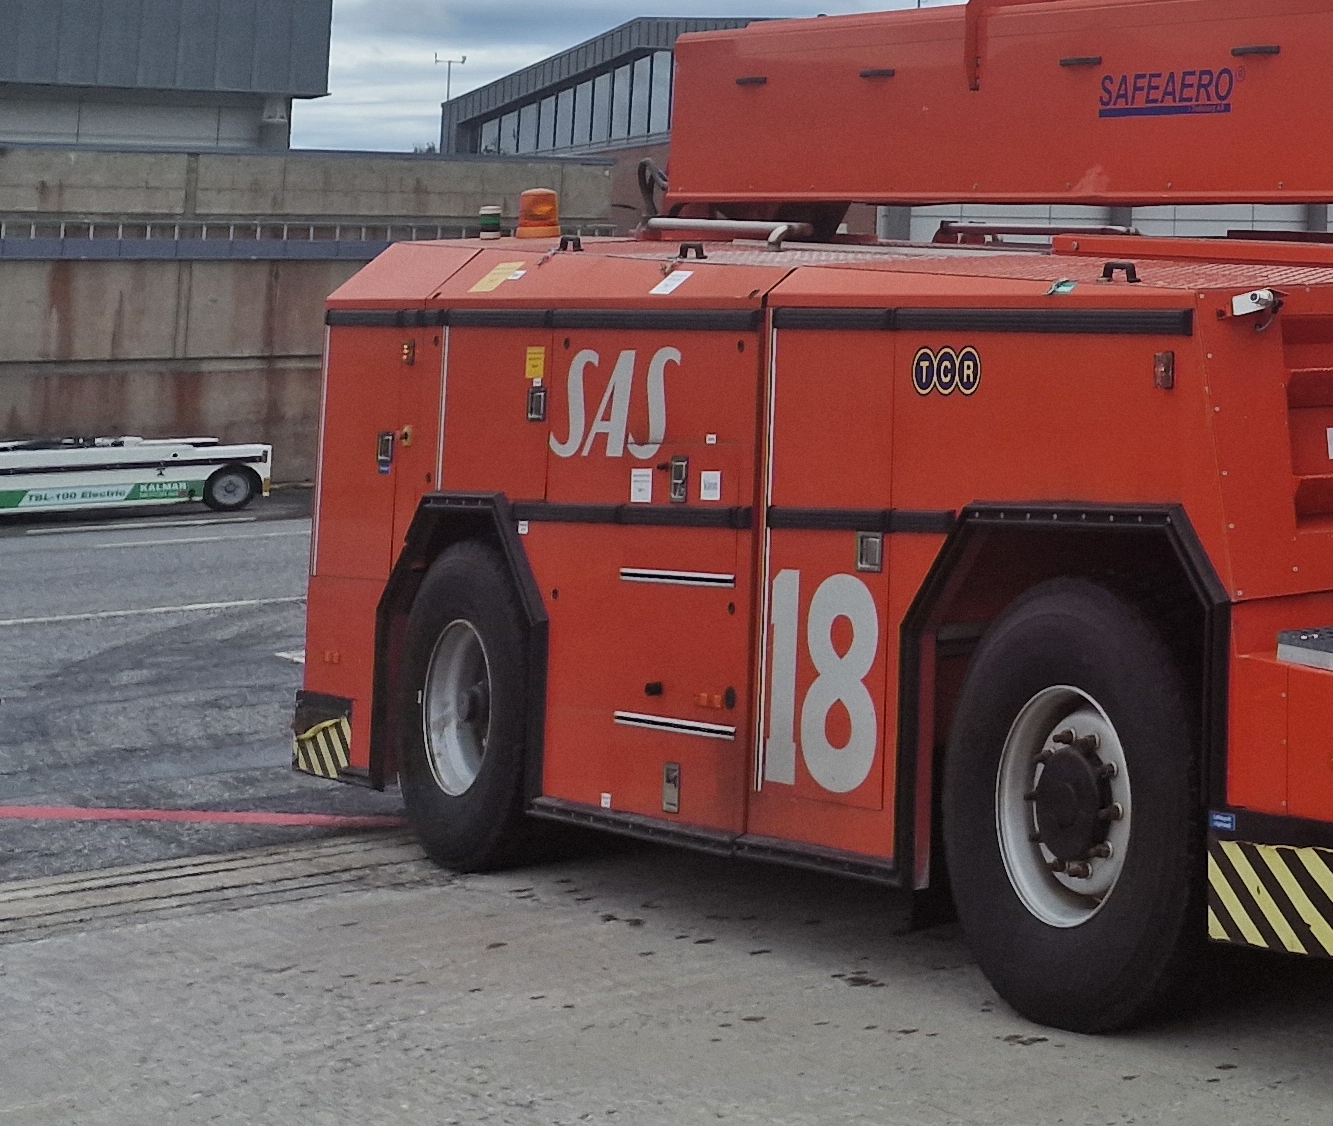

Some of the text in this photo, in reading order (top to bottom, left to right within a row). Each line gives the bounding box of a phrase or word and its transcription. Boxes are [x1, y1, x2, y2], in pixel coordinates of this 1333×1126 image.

[1099, 67, 1234, 107] SAFEAERO
[917, 356, 978, 387] TCR
[549, 346, 682, 460] SAS
[80, 488, 126, 500] Electric
[764, 569, 879, 793] 18
